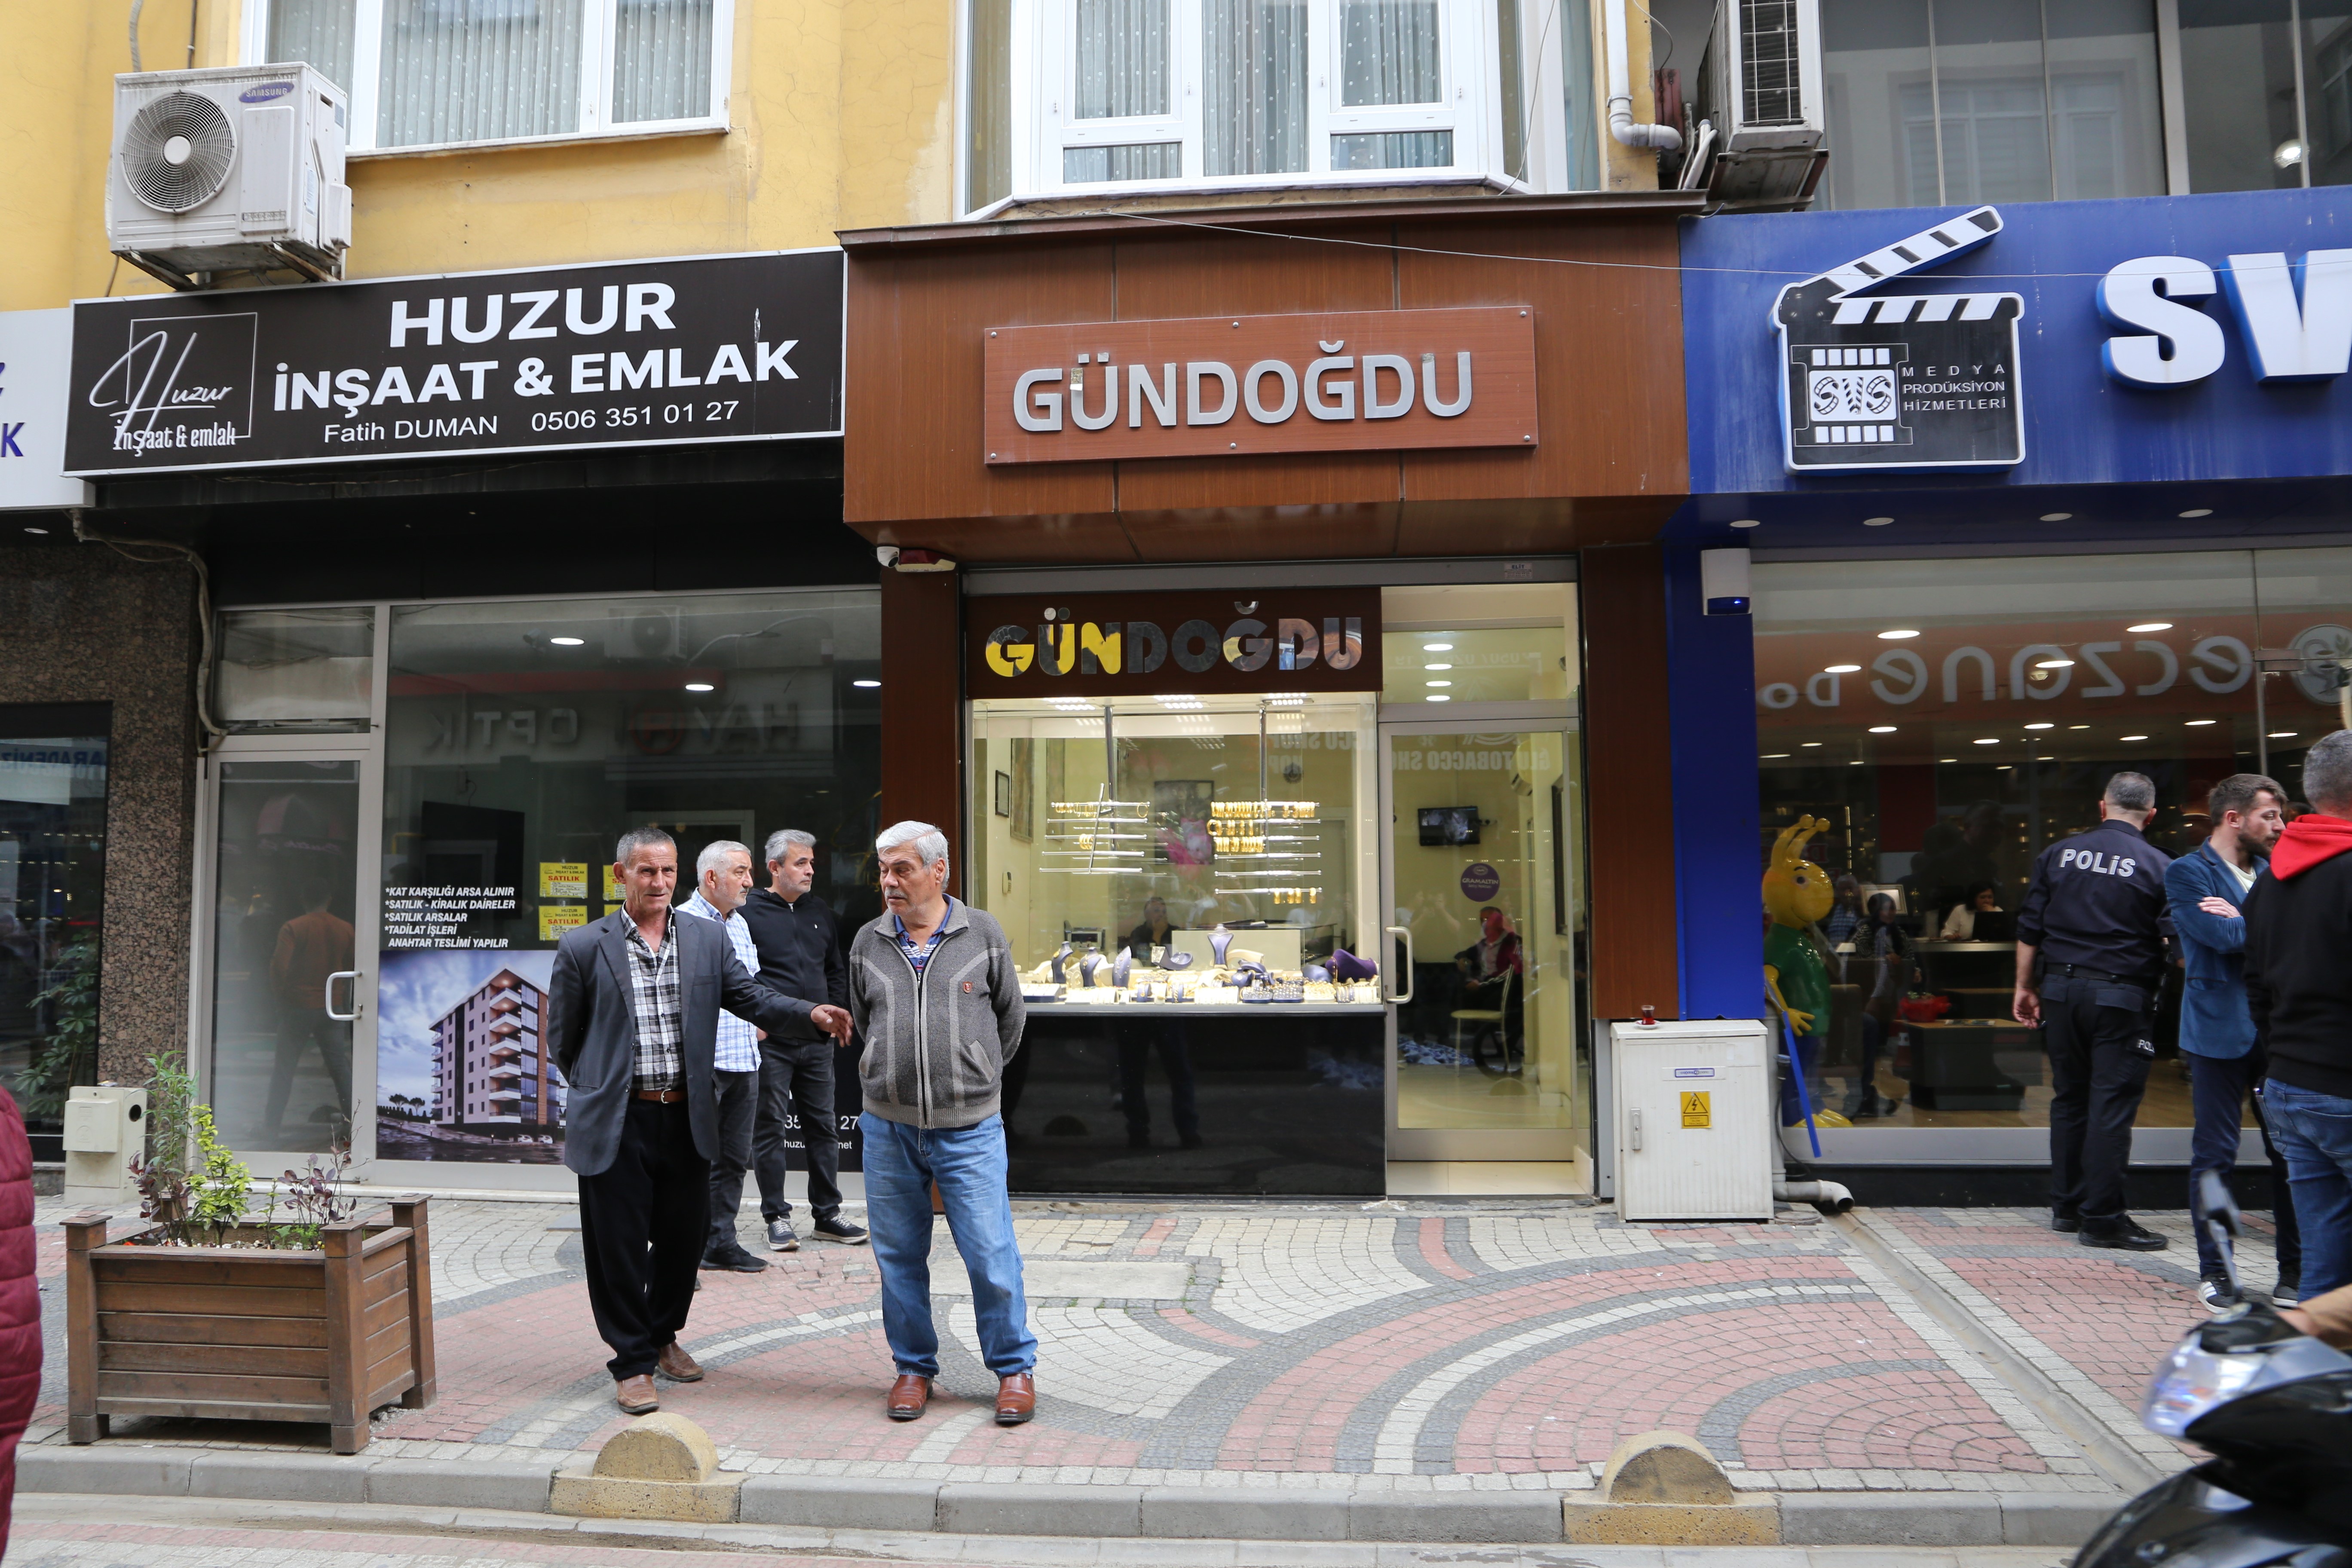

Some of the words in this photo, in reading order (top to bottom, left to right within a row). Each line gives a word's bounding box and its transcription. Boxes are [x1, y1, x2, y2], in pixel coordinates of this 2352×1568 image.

[245, 87, 288, 97] SAMSUNG
[390, 282, 677, 348] HUZUR
[2098, 248, 2352, 387] SV
[274, 362, 499, 418] İNŞAAT
[514, 357, 555, 397] &
[570, 340, 799, 394] EMLAK
[1013, 340, 1473, 432] GÜNDOĞDU
[89, 330, 234, 450] Huzur
[1902, 380, 2006, 394] PRODÜKSİYON
[1904, 396, 2006, 411] HİZMETLERİ
[324, 423, 385, 443] Fatih
[394, 416, 498, 440] DUMAN
[531, 409, 596, 432] 0506
[605, 406, 651, 427] 351
[663, 403, 693, 424] 01
[705, 400, 739, 421] 27
[175, 424, 188, 448] &
[190, 421, 236, 447] emlak
[985, 601, 1363, 677] GÜNDOĞDU
[408, 885, 455, 899] KARŞILIĞI
[456, 887, 481, 896] ARSA
[483, 887, 515, 896] ALINIR
[430, 897, 468, 909] KİRALIK
[469, 897, 516, 909] DAİRELER
[424, 913, 468, 922] ARSALAR
[427, 923, 457, 937] İŞLERİ
[388, 938, 432, 947] ANAHTAR
[434, 936, 472, 948] TESLİMİ
[472, 938, 509, 948] YAPILIR
[2137, 1039, 2155, 1054] POL
[784, 1115, 801, 1129] 35
[840, 1116, 859, 1130] 27
[784, 1139, 805, 1148] huzu
[838, 1141, 852, 1149] net
